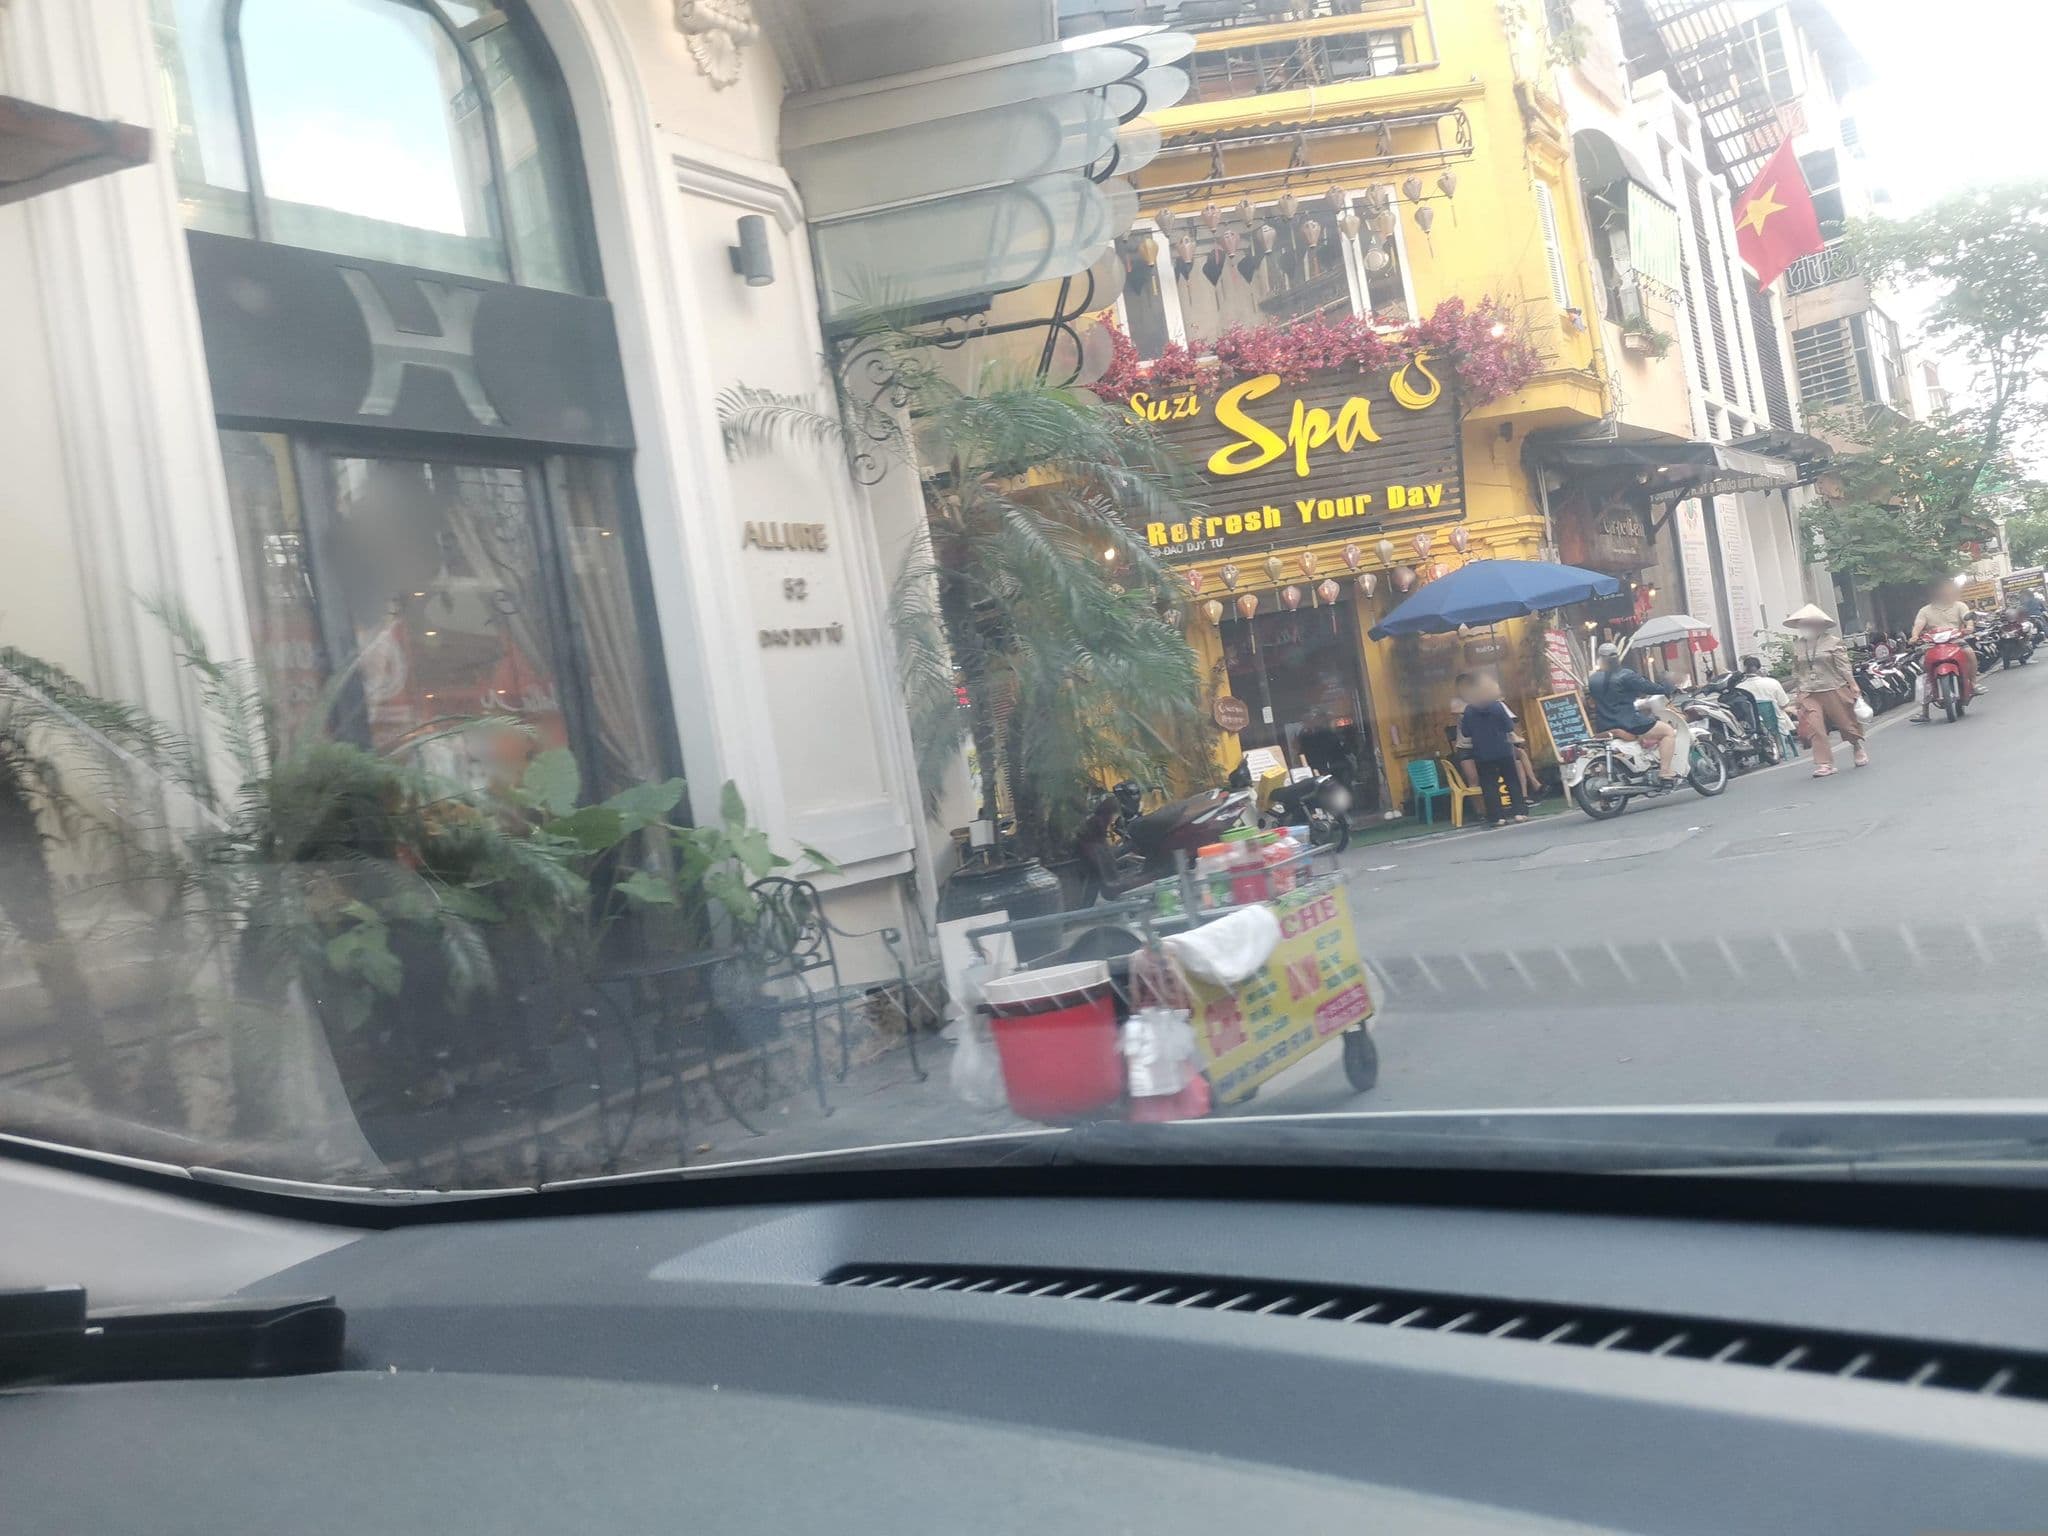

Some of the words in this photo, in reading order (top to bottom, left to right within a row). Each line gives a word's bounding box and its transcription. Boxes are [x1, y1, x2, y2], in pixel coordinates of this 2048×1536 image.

[1125, 385, 1201, 425] Suzi
[1207, 373, 1382, 478] Spa
[1146, 505, 1282, 547] Refresh
[1296, 494, 1372, 524] Your
[1386, 482, 1444, 511] Day
